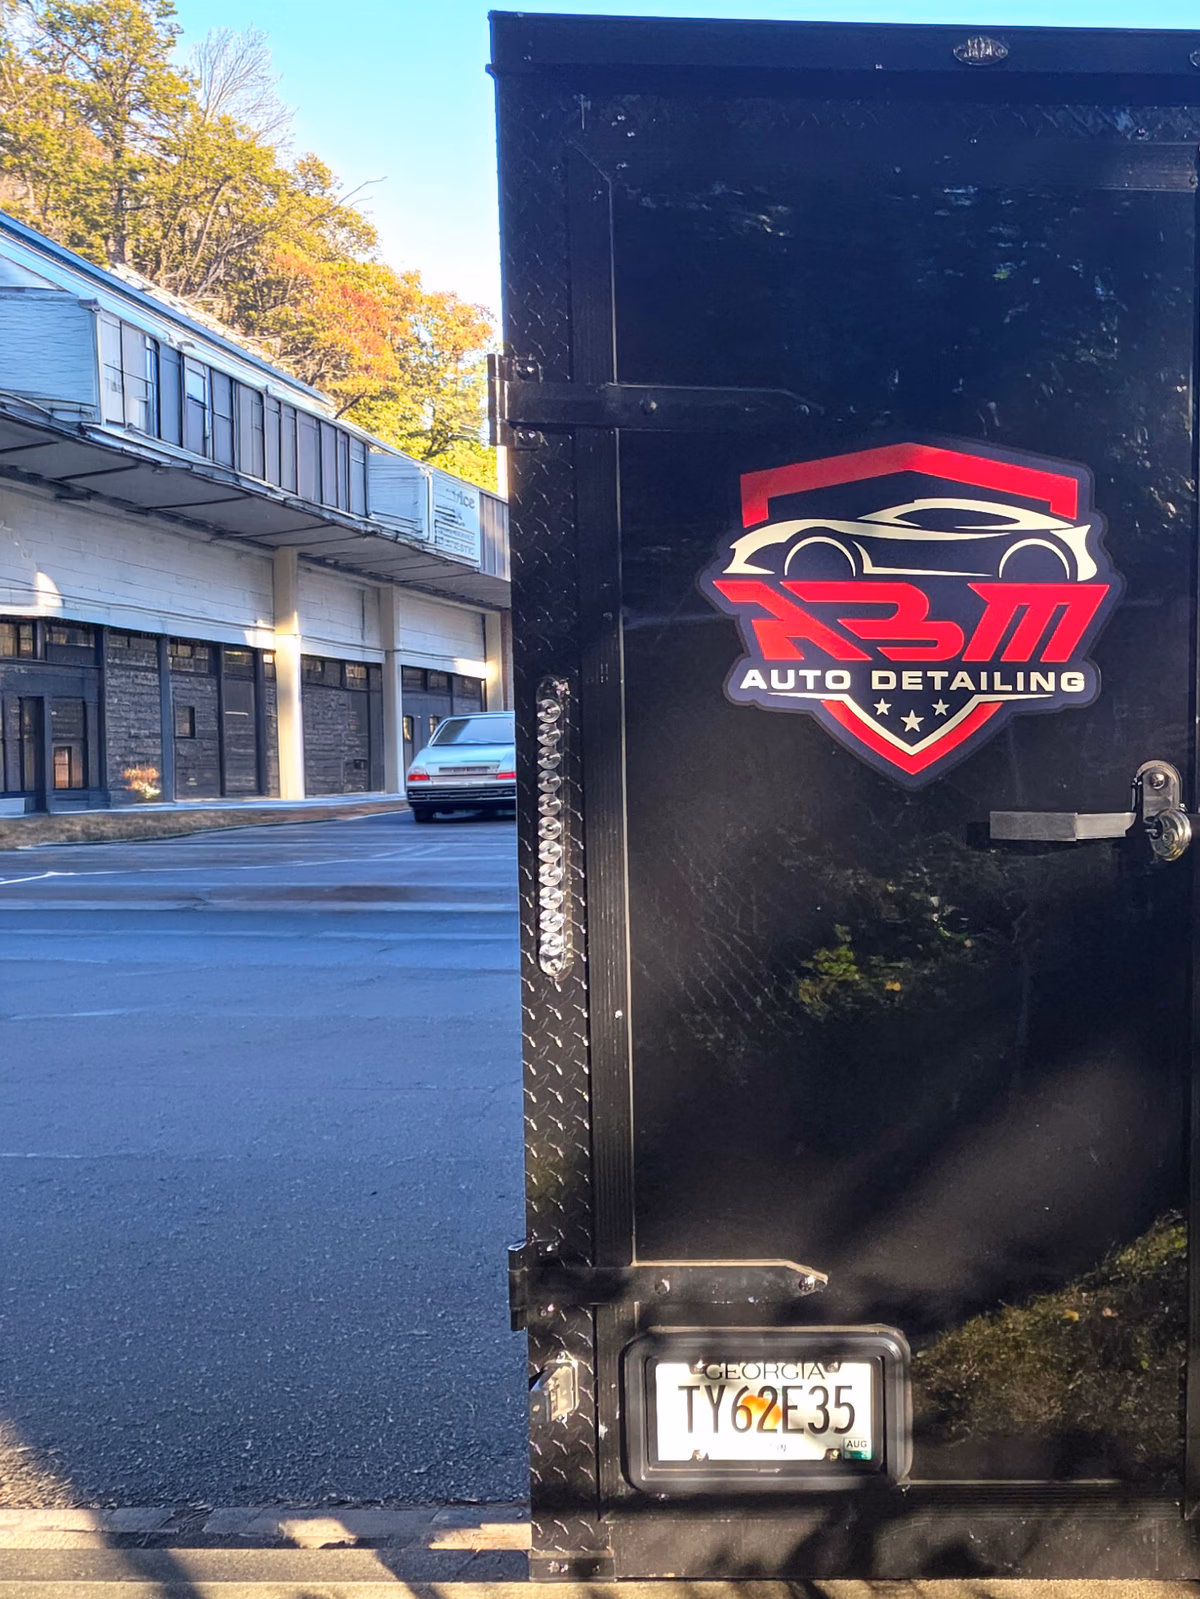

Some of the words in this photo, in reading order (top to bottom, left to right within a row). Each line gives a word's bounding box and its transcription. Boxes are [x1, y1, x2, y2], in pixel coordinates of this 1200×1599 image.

[712, 580, 1110, 663] ABM
[740, 669, 851, 689] AUTO
[872, 670, 1085, 691] DETAILING
[704, 1363, 826, 1380] GEORGIA
[678, 1385, 856, 1434] TY62E35
[846, 1440, 867, 1449] AUG
